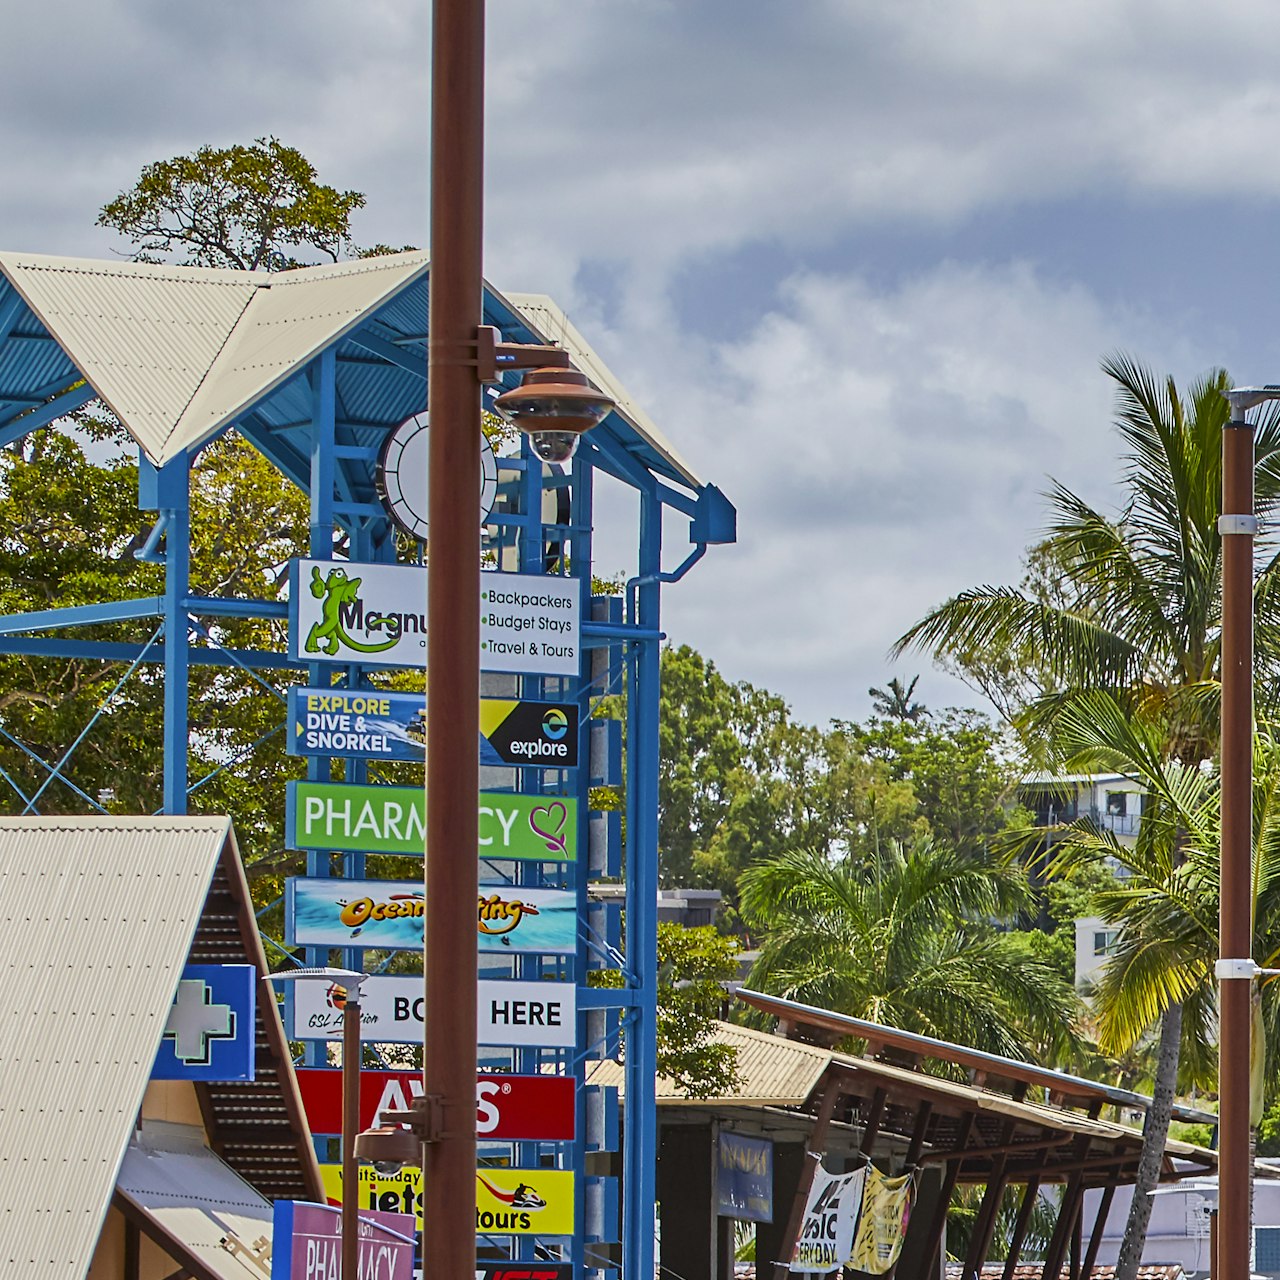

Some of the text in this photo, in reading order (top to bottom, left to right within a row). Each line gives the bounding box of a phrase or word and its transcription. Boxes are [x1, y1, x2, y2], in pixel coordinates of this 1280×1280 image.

[489, 590, 572, 609] Backpackers
[339, 599, 428, 639] Magnu
[488, 614, 572, 634] Budget Stays
[488, 640, 574, 658] Travel & Tours
[307, 695, 390, 716] EXPLORE
[306, 713, 367, 733] DIVE &
[306, 732, 392, 752] SNORKEL
[510, 738, 568, 758] explore
[305, 796, 519, 847] PHARMCY
[308, 1012, 331, 1028] GSL
[394, 996, 561, 1027] BO HERE
[371, 1079, 500, 1134] AS
